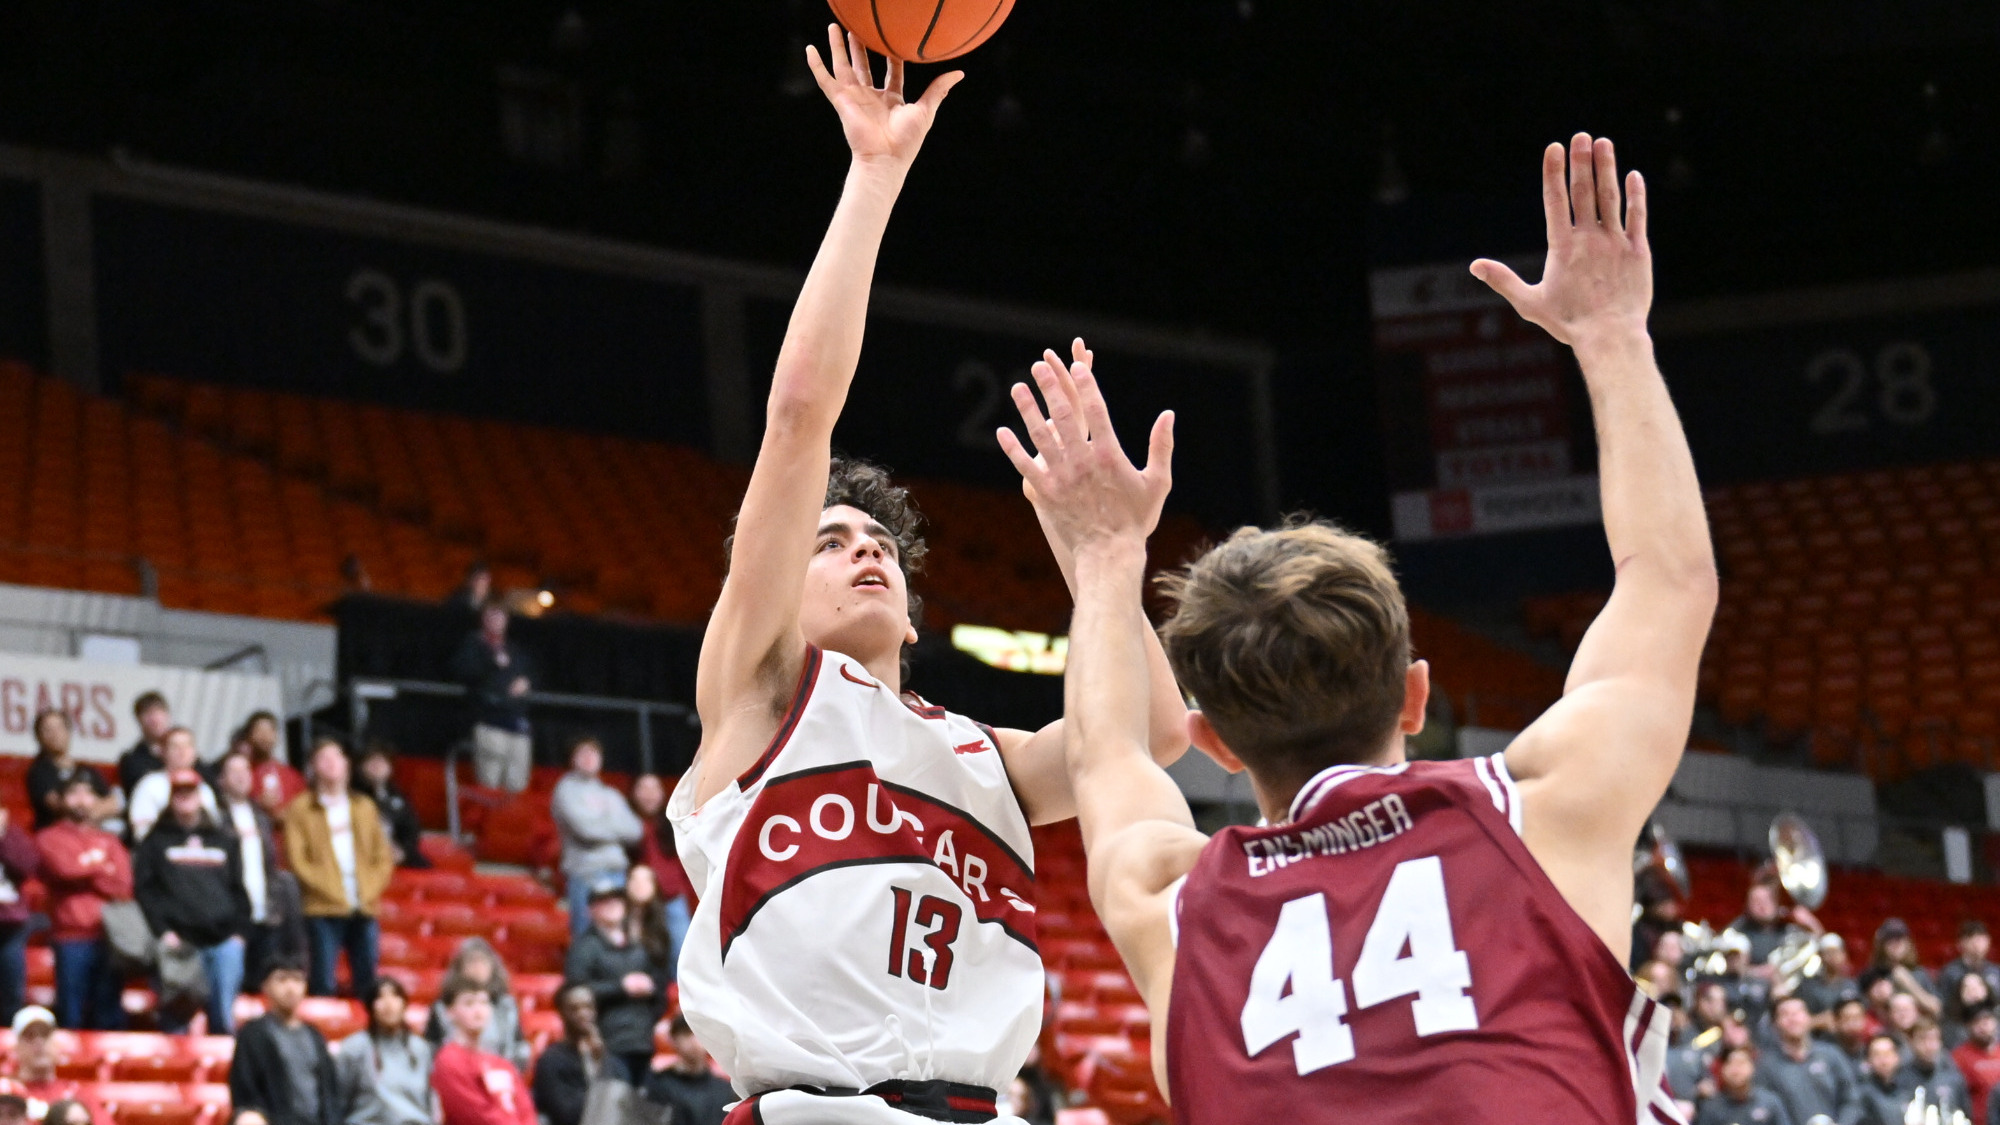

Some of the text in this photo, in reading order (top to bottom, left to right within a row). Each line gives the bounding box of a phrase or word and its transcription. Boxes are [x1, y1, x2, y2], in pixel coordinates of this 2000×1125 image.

[345, 268, 467, 374] 30
[1805, 342, 1937, 435] 28
[2, 678, 116, 740] GARS
[1243, 793, 1413, 878] ENSMINGER
[888, 885, 962, 991] 13
[1240, 855, 1479, 1077] 44
